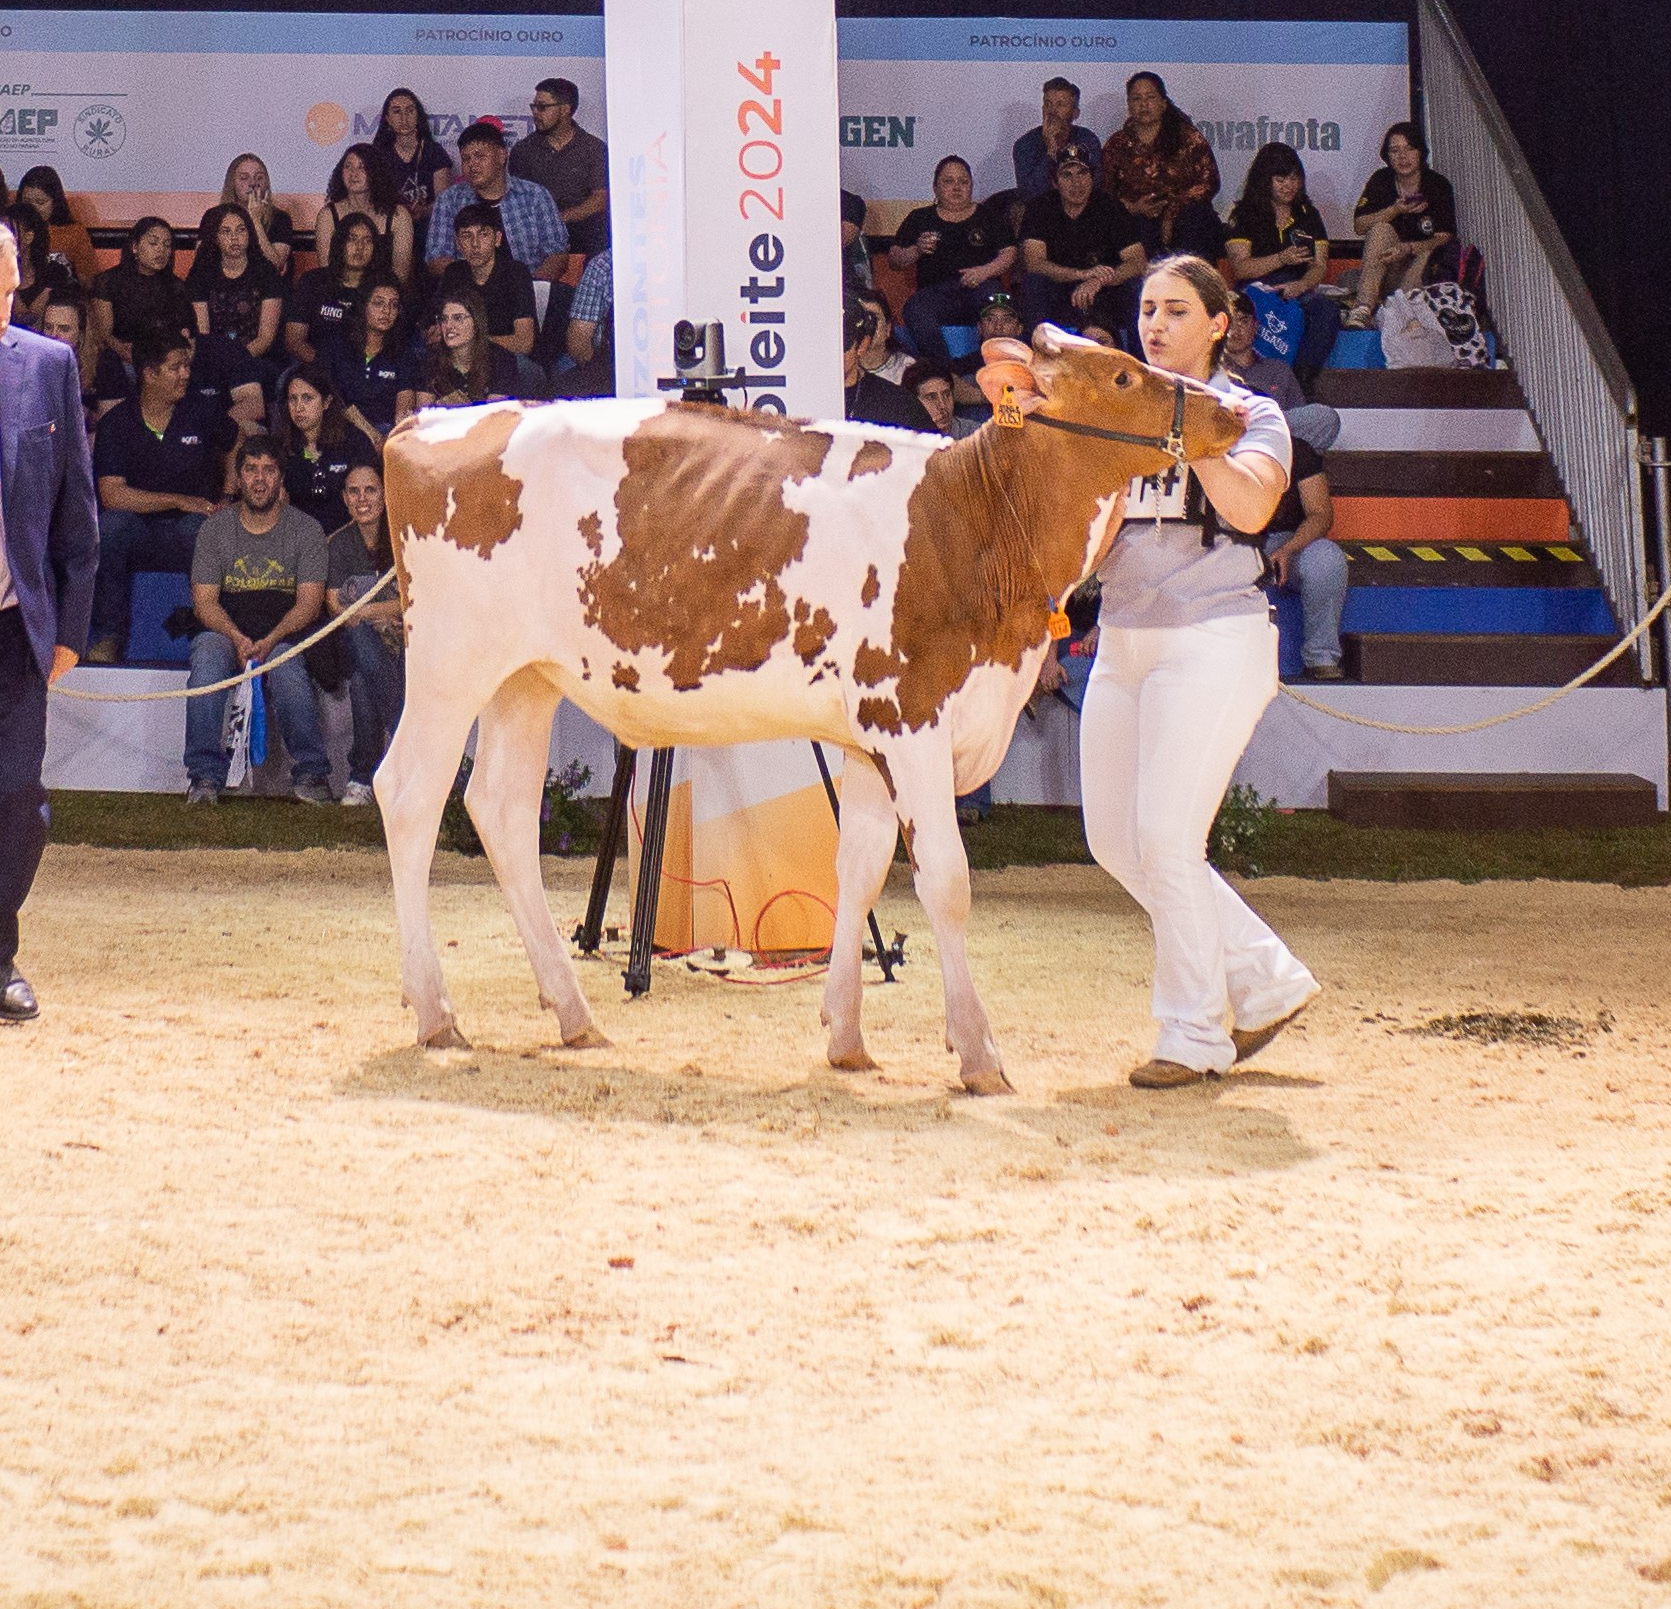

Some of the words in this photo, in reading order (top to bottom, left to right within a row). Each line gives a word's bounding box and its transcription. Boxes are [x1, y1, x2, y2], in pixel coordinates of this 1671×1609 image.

[415, 26, 513, 42] PATROCÍNIO
[516, 29, 564, 43] OURO
[970, 33, 1067, 49] PATROCÍNIO
[1071, 36, 1117, 49] OURO
[78, 106, 123, 123] SINDICATO
[737, 51, 784, 220] 2024
[80, 144, 118, 158] RURAL
[320, 305, 343, 319] KING
